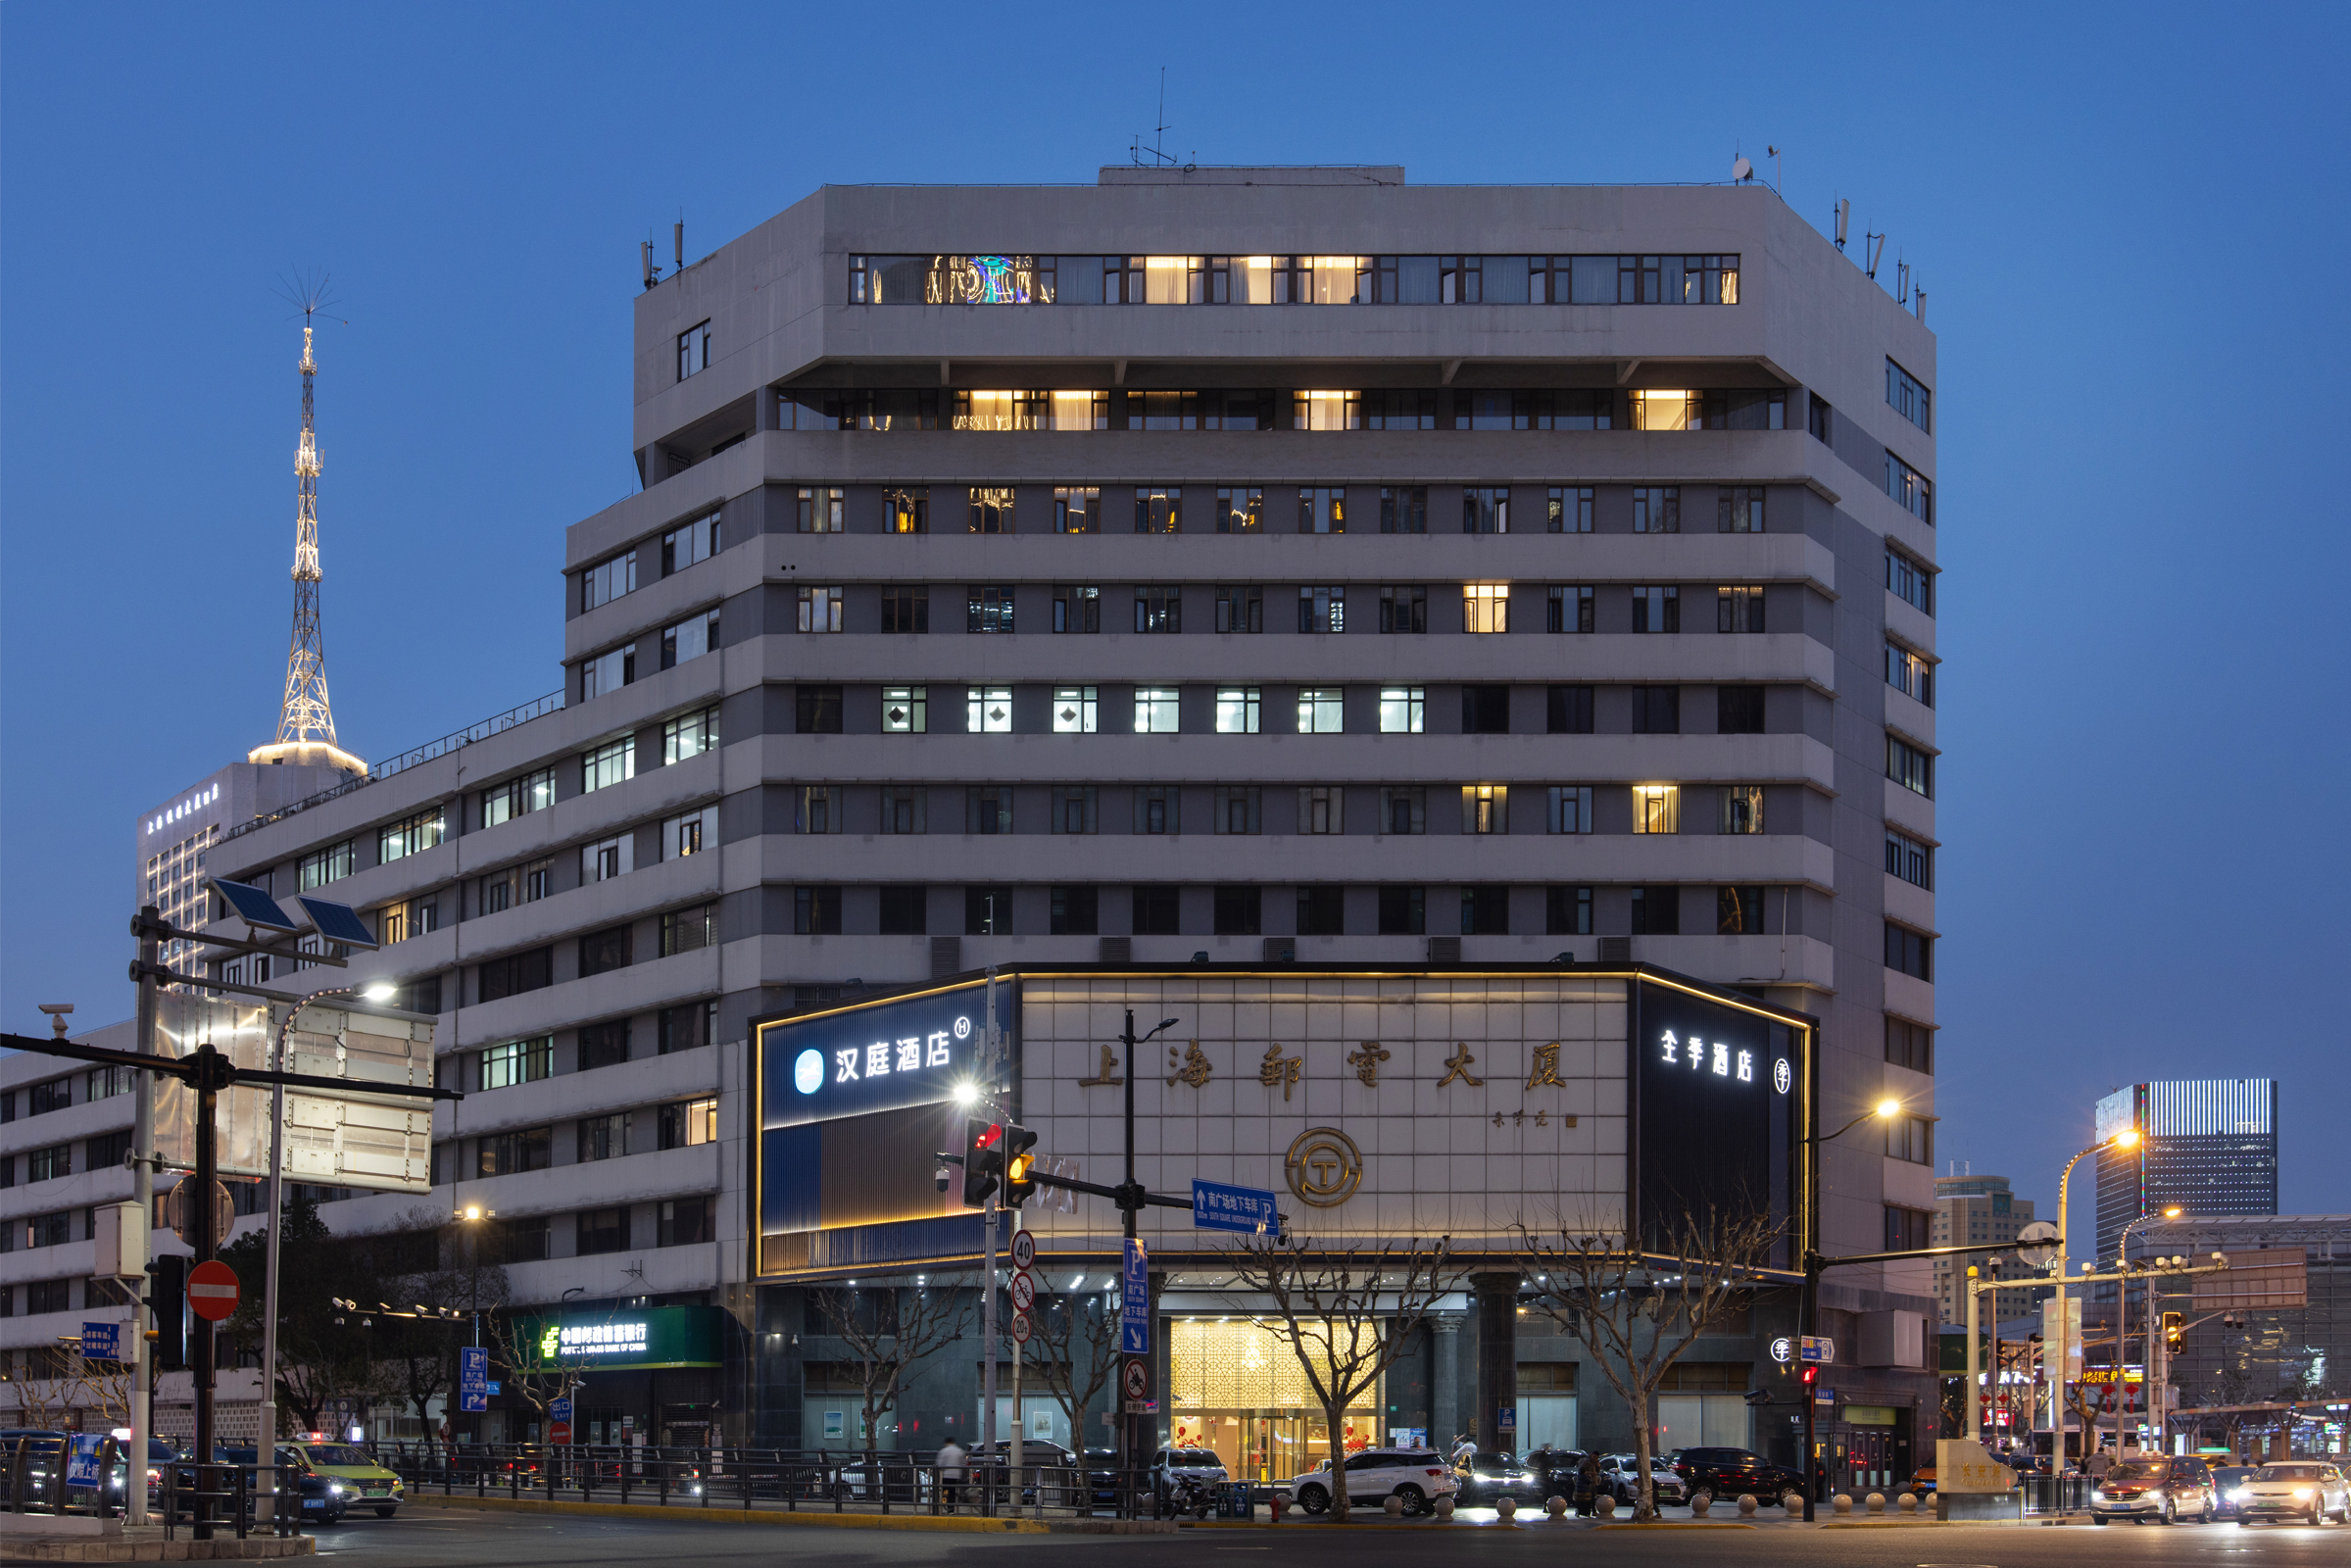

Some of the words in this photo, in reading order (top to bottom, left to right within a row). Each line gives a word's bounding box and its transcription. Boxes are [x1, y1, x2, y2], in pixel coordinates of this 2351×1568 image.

[836, 1030, 950, 1083] 汉庭酒店
[1660, 1029, 1752, 1083] 全季酒店
[1207, 1191, 1259, 1214] 南广场地下车库
[1262, 1201, 1272, 1224] P
[1016, 1241, 1030, 1260] 40
[1130, 1250, 1141, 1276] P
[561, 1323, 647, 1346] 中国邮政储蓄银行
[1015, 1319, 1028, 1335] 20t
[468, 1352, 480, 1369] P
[552, 1401, 570, 1411] 出口
[1504, 1408, 1511, 1417] P
[69, 1462, 100, 1481] 仅限上桥
